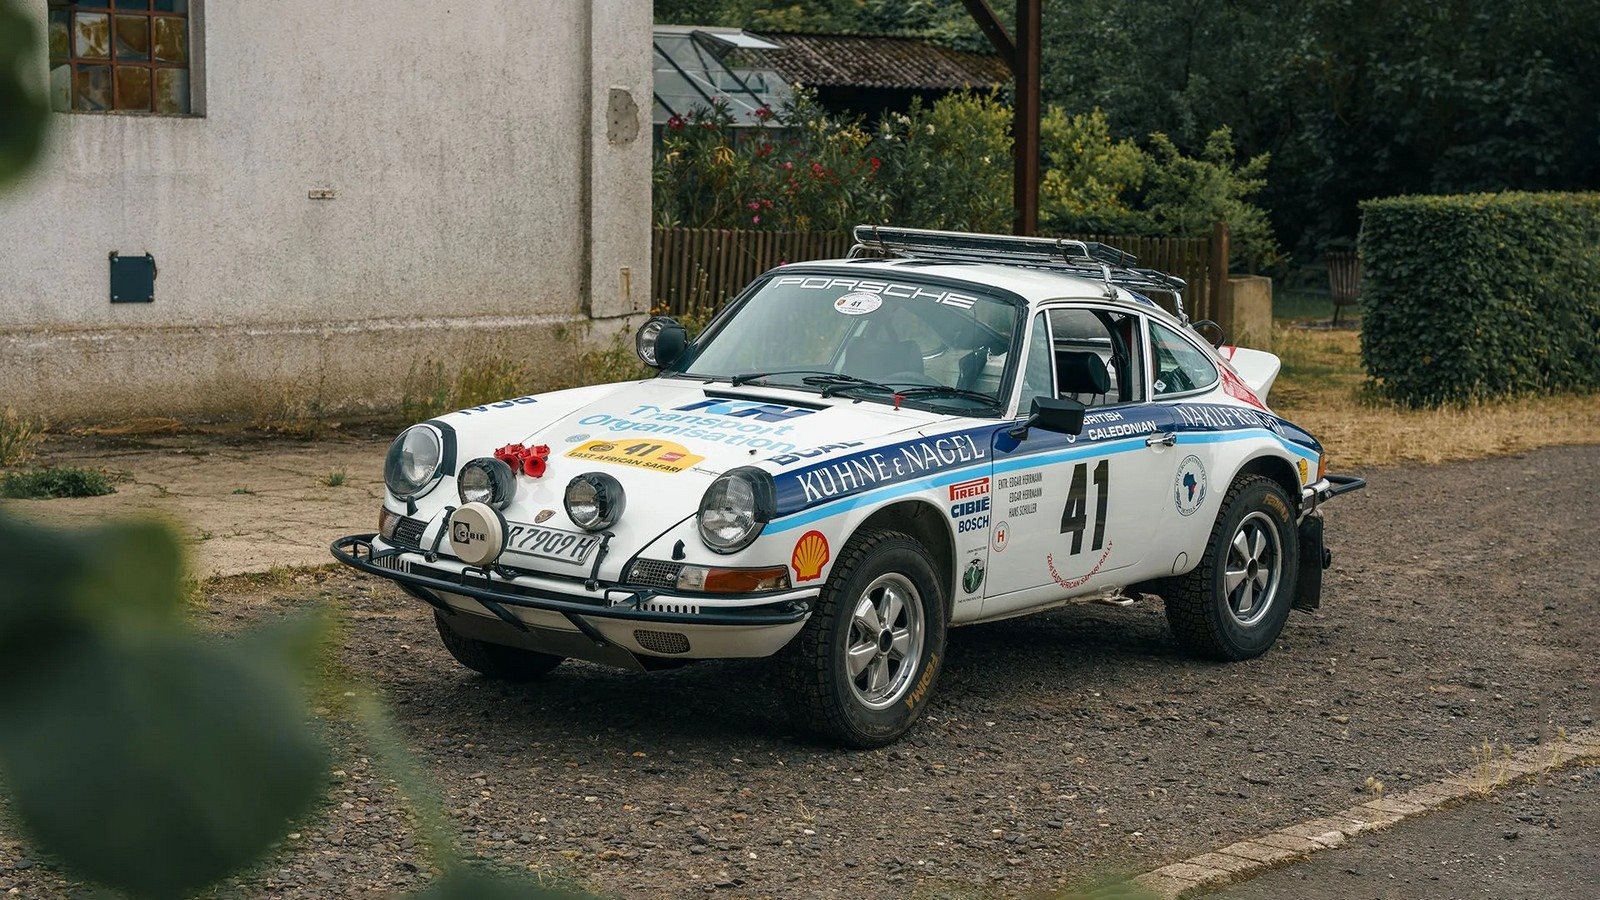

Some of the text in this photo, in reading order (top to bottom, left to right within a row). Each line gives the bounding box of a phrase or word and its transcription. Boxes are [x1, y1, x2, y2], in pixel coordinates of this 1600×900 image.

[774, 277, 979, 309] PORSCHE
[631, 405, 795, 435] Transport
[1088, 420, 1158, 441] CALEDONIAN
[578, 414, 796, 453] Organisation
[569, 452, 683, 473] EAST AFRICAN SAFARI
[624, 443, 663, 457] 41
[796, 452, 892, 503] KÜHNE
[900, 434, 985, 473] NAGEL
[949, 477, 989, 501] PIRELLI
[1060, 459, 1109, 556] 41
[958, 514, 989, 533] BOSCH
[997, 530, 1005, 543] H
[1098, 540, 1113, 566] RALLY
[905, 652, 939, 710] FEDIMA
